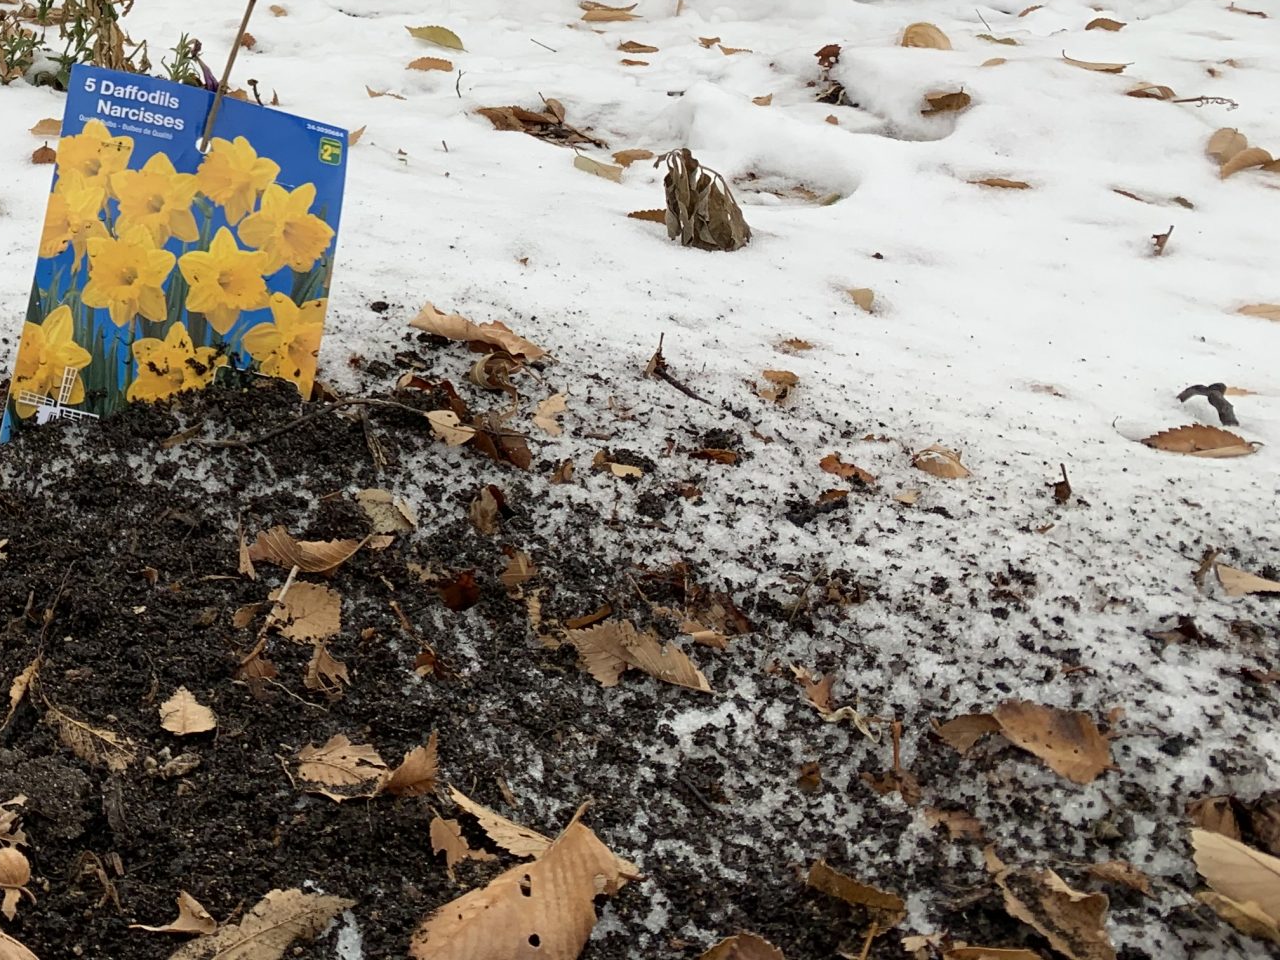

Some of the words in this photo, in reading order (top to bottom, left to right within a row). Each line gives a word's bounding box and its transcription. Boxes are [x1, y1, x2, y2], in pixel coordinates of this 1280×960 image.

[84, 77, 96, 92] 5
[100, 80, 180, 109] Daffodils
[96, 99, 185, 131] Narcisses
